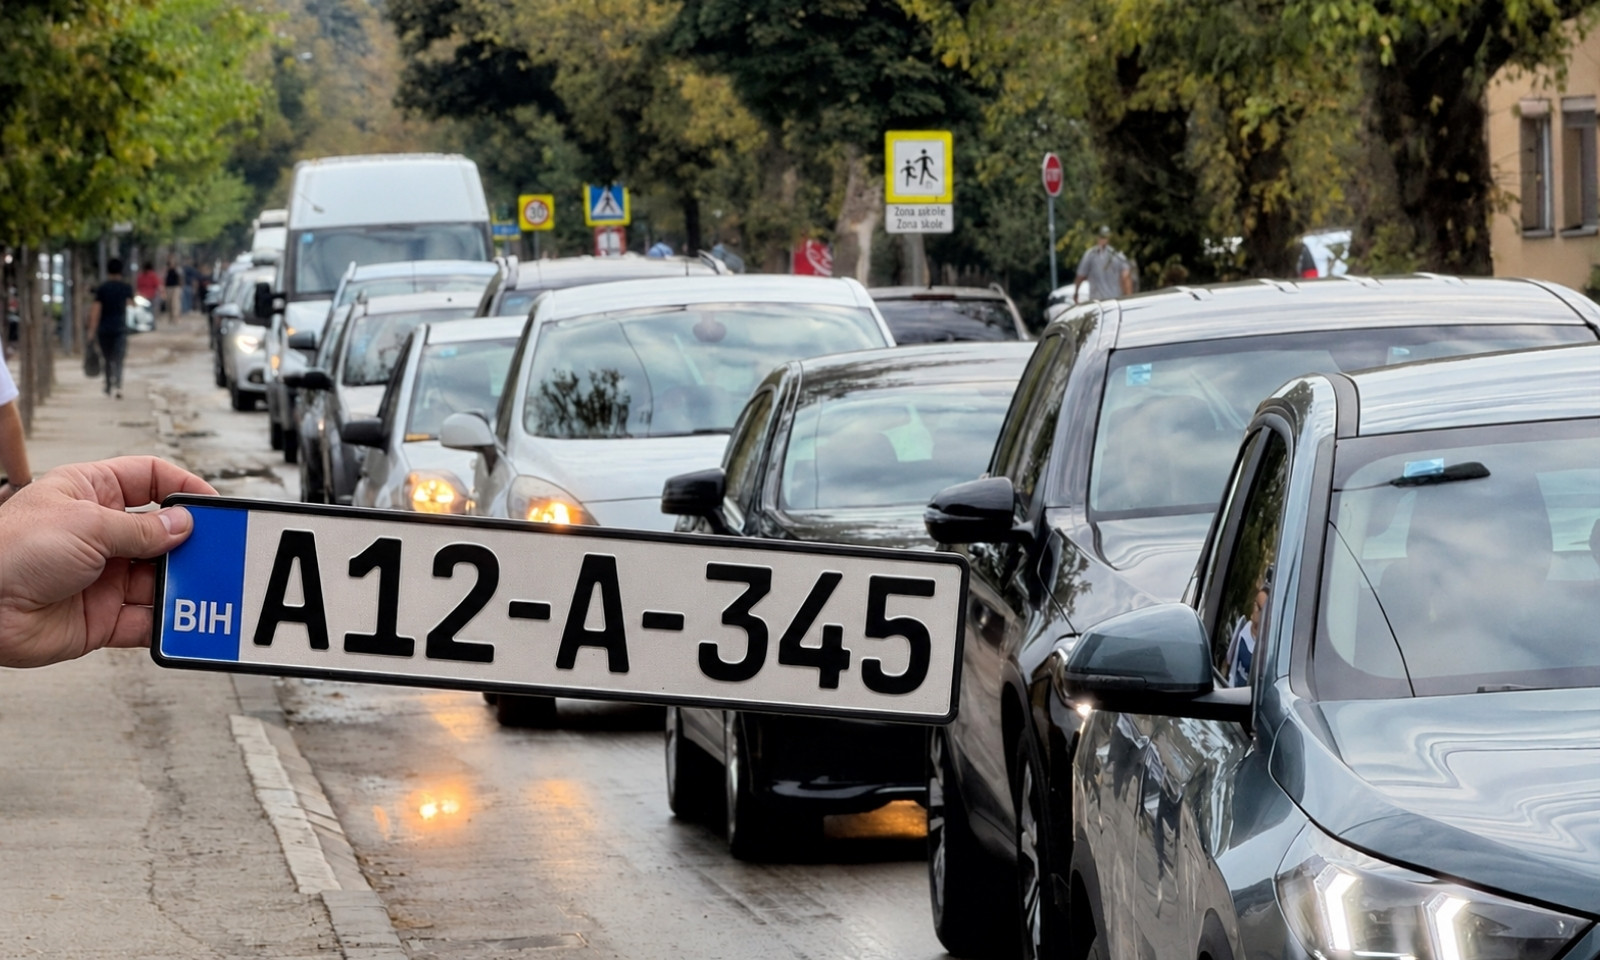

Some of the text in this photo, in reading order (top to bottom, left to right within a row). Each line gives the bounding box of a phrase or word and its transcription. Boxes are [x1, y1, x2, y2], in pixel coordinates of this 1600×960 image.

[530, 206, 545, 220] 30
[894, 206, 915, 216] Zona
[897, 218, 918, 229] Zona
[173, 598, 233, 635] BIH
[254, 530, 936, 694] A12-A-345
